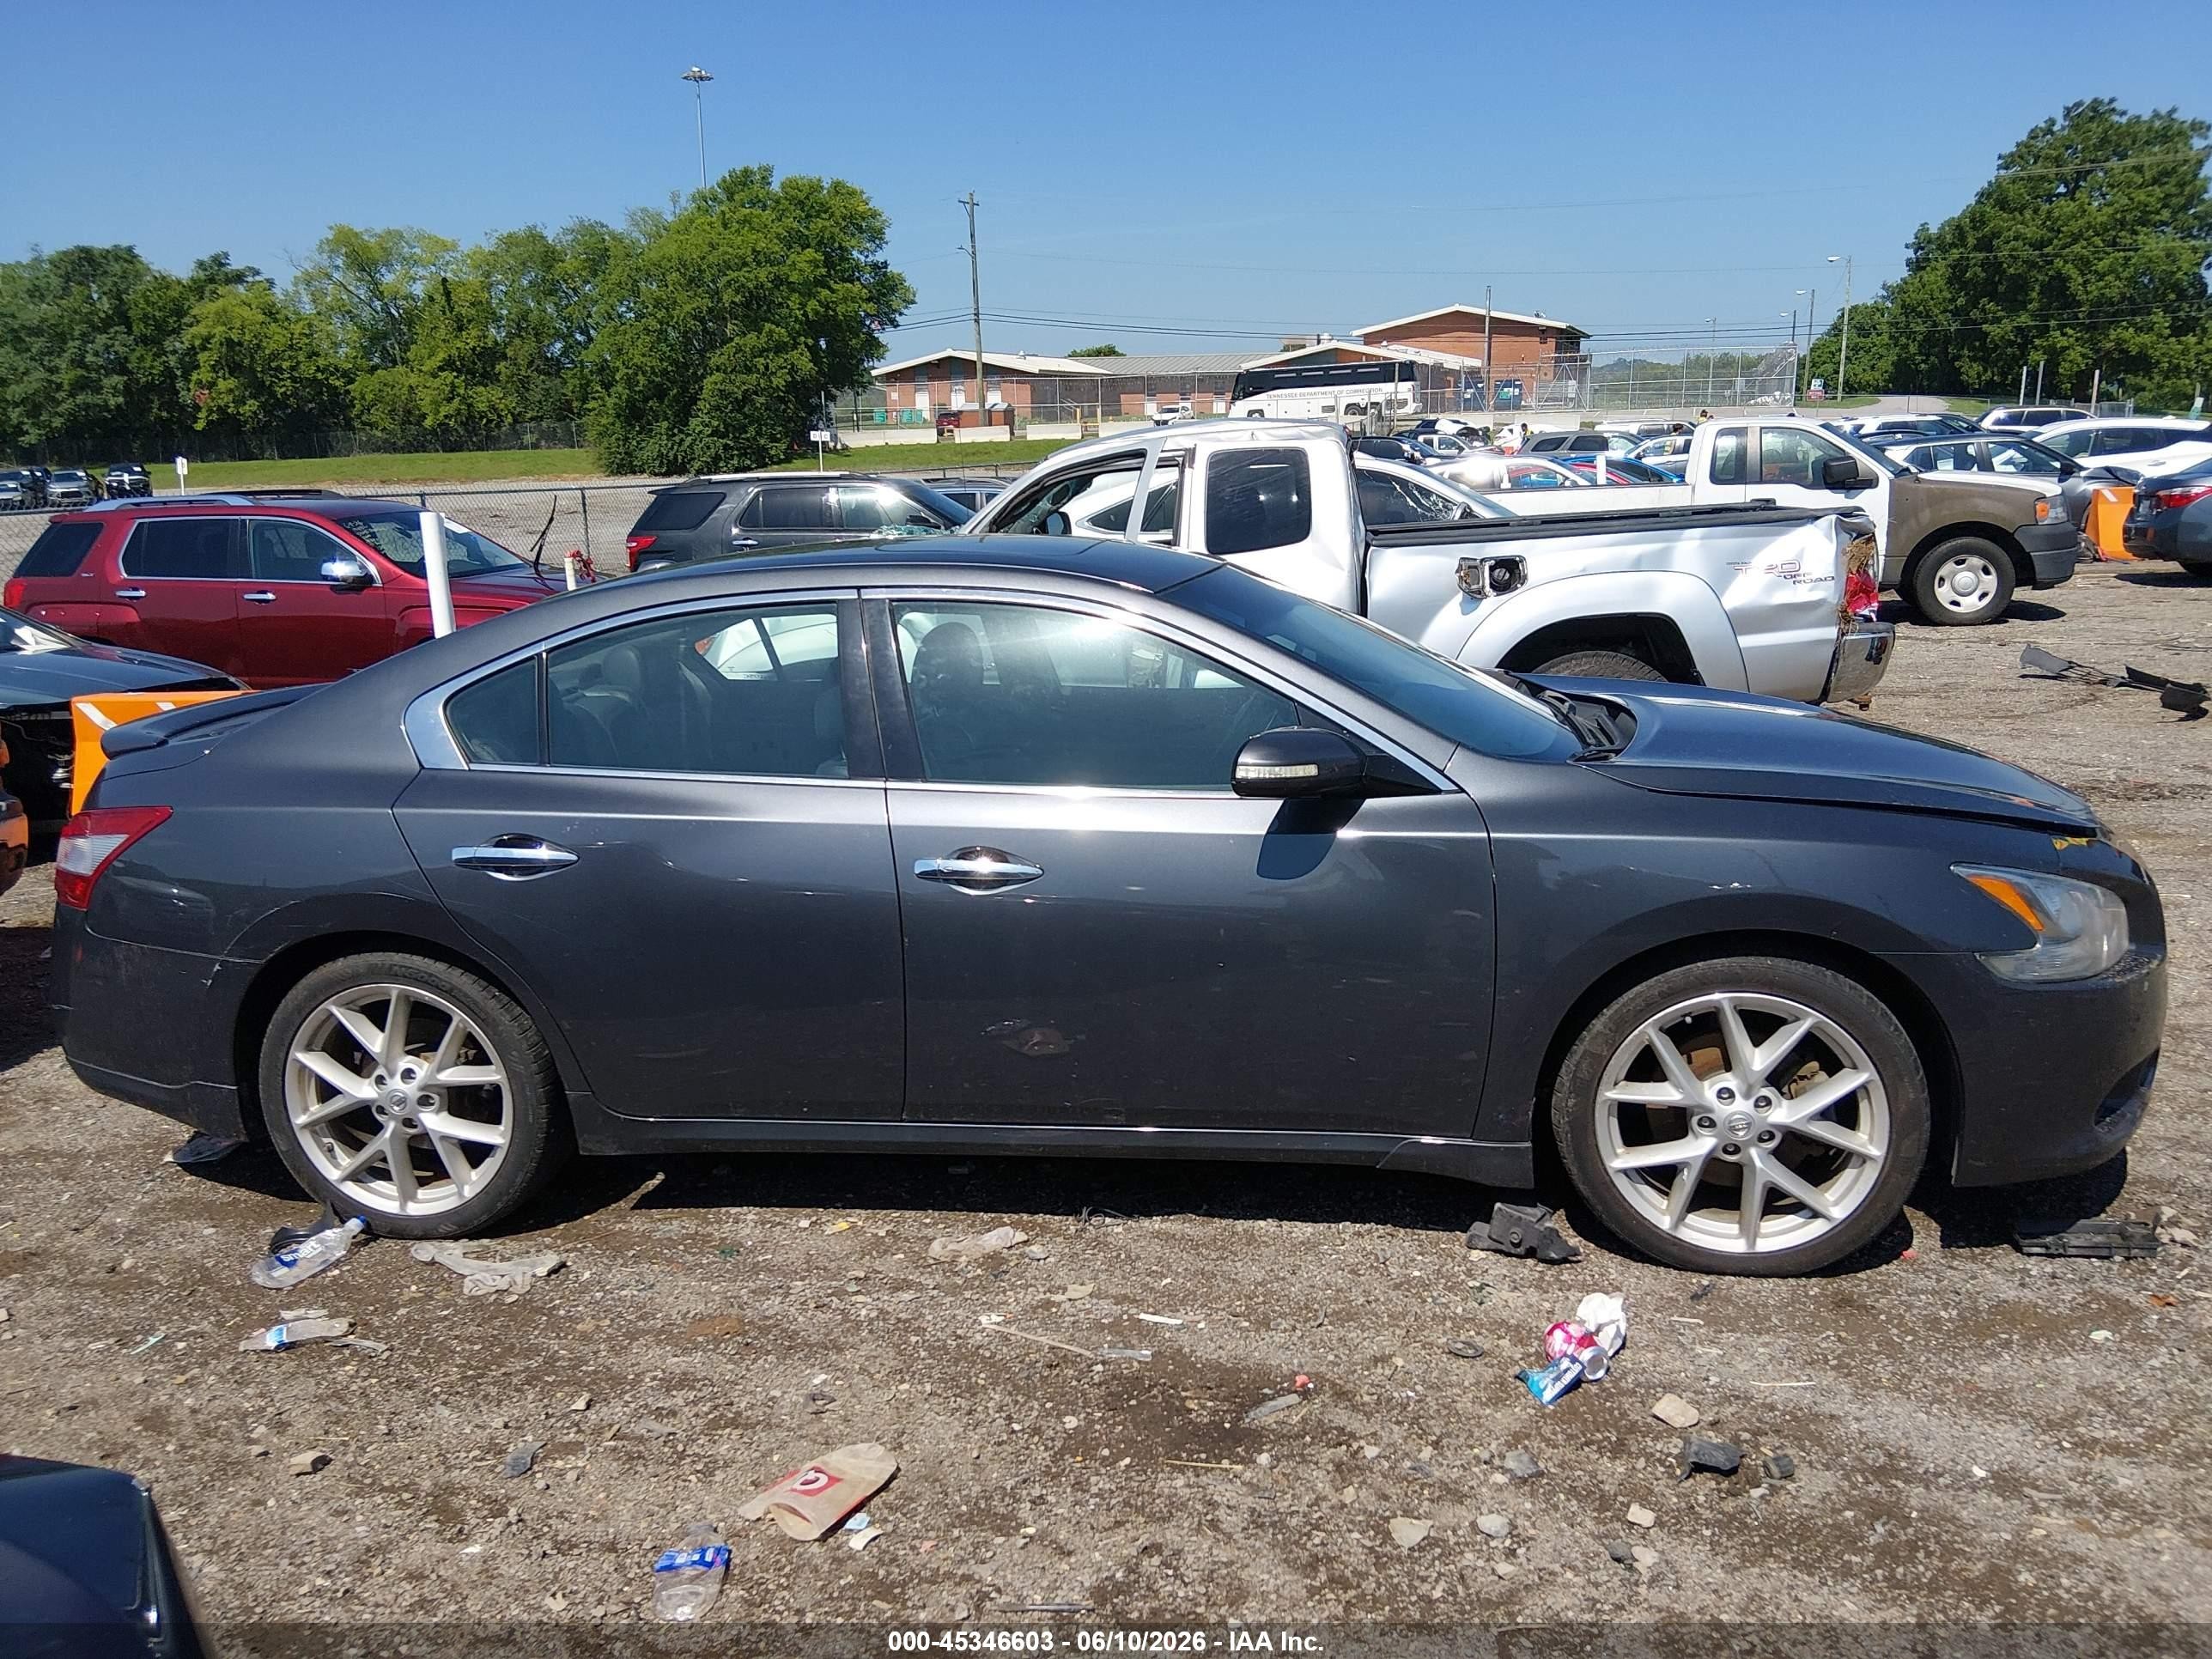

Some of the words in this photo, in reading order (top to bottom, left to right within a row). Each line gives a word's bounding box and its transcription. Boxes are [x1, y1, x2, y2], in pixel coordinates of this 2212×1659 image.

[1734, 559, 1801, 578] TRD
[1793, 575, 1835, 586] ROAD
[280, 1240, 322, 1262] smart
